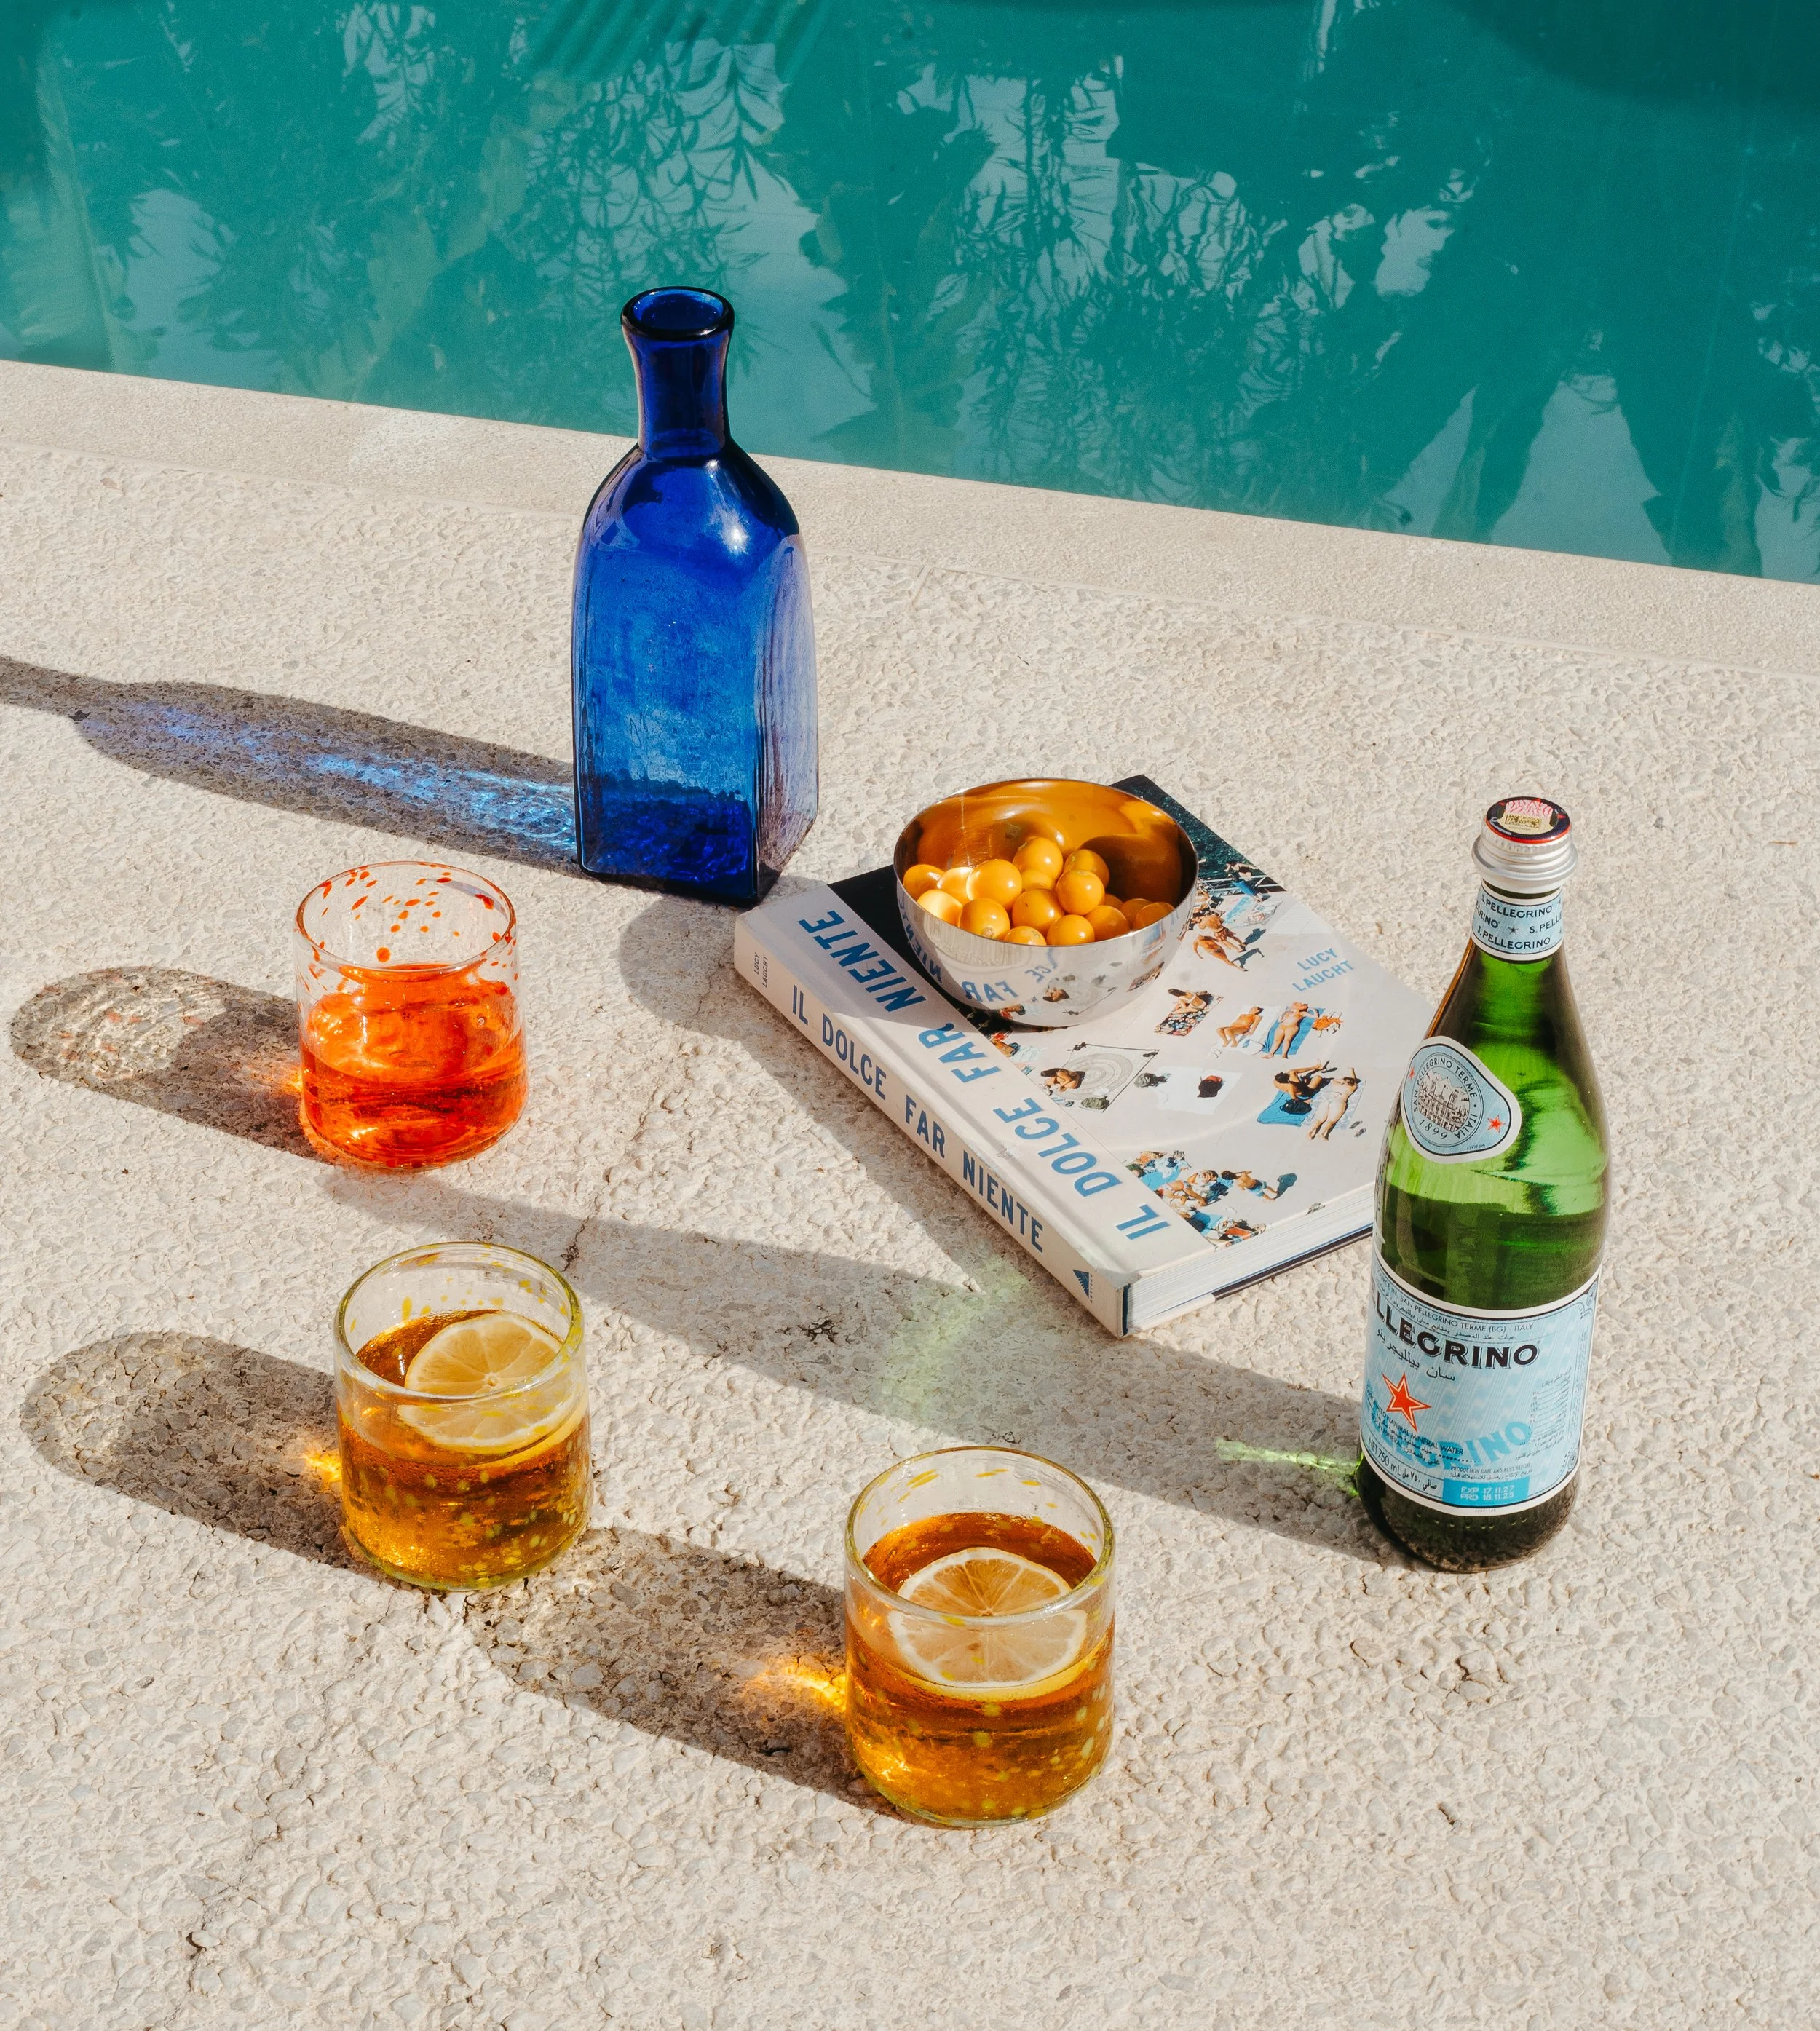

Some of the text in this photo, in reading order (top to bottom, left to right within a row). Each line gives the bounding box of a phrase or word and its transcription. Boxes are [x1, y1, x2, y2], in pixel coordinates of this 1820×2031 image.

[1297, 948, 1337, 971] LUCY
[1291, 960, 1354, 991] LAUCHT
[798, 910, 1170, 1240] IL DOLCE FAR NIENTE
[1416, 1057, 1452, 1086] PELLEGRINO
[1455, 1066, 1478, 1098] TERME
[792, 985, 1043, 1254] IL DOLCE FAR NIENTE
[1419, 1119, 1448, 1139] 1899
[1454, 1113, 1478, 1139] ITALIA
[1415, 1305, 1458, 1327] PELLEGRINO
[1460, 1322, 1486, 1332] TERME
[1489, 1325, 1506, 1333] (BG)
[1514, 1323, 1534, 1331] ITALY
[1426, 1366, 1455, 1382] سان
[1410, 1433, 1438, 1449] MINERAL
[1441, 1444, 1463, 1455] WATER
[1377, 1447, 1390, 1466] 750
[1390, 1462, 1401, 1476] mL
[1460, 1493, 1479, 1501] PRD
[1461, 1486, 1479, 1494] EXP
